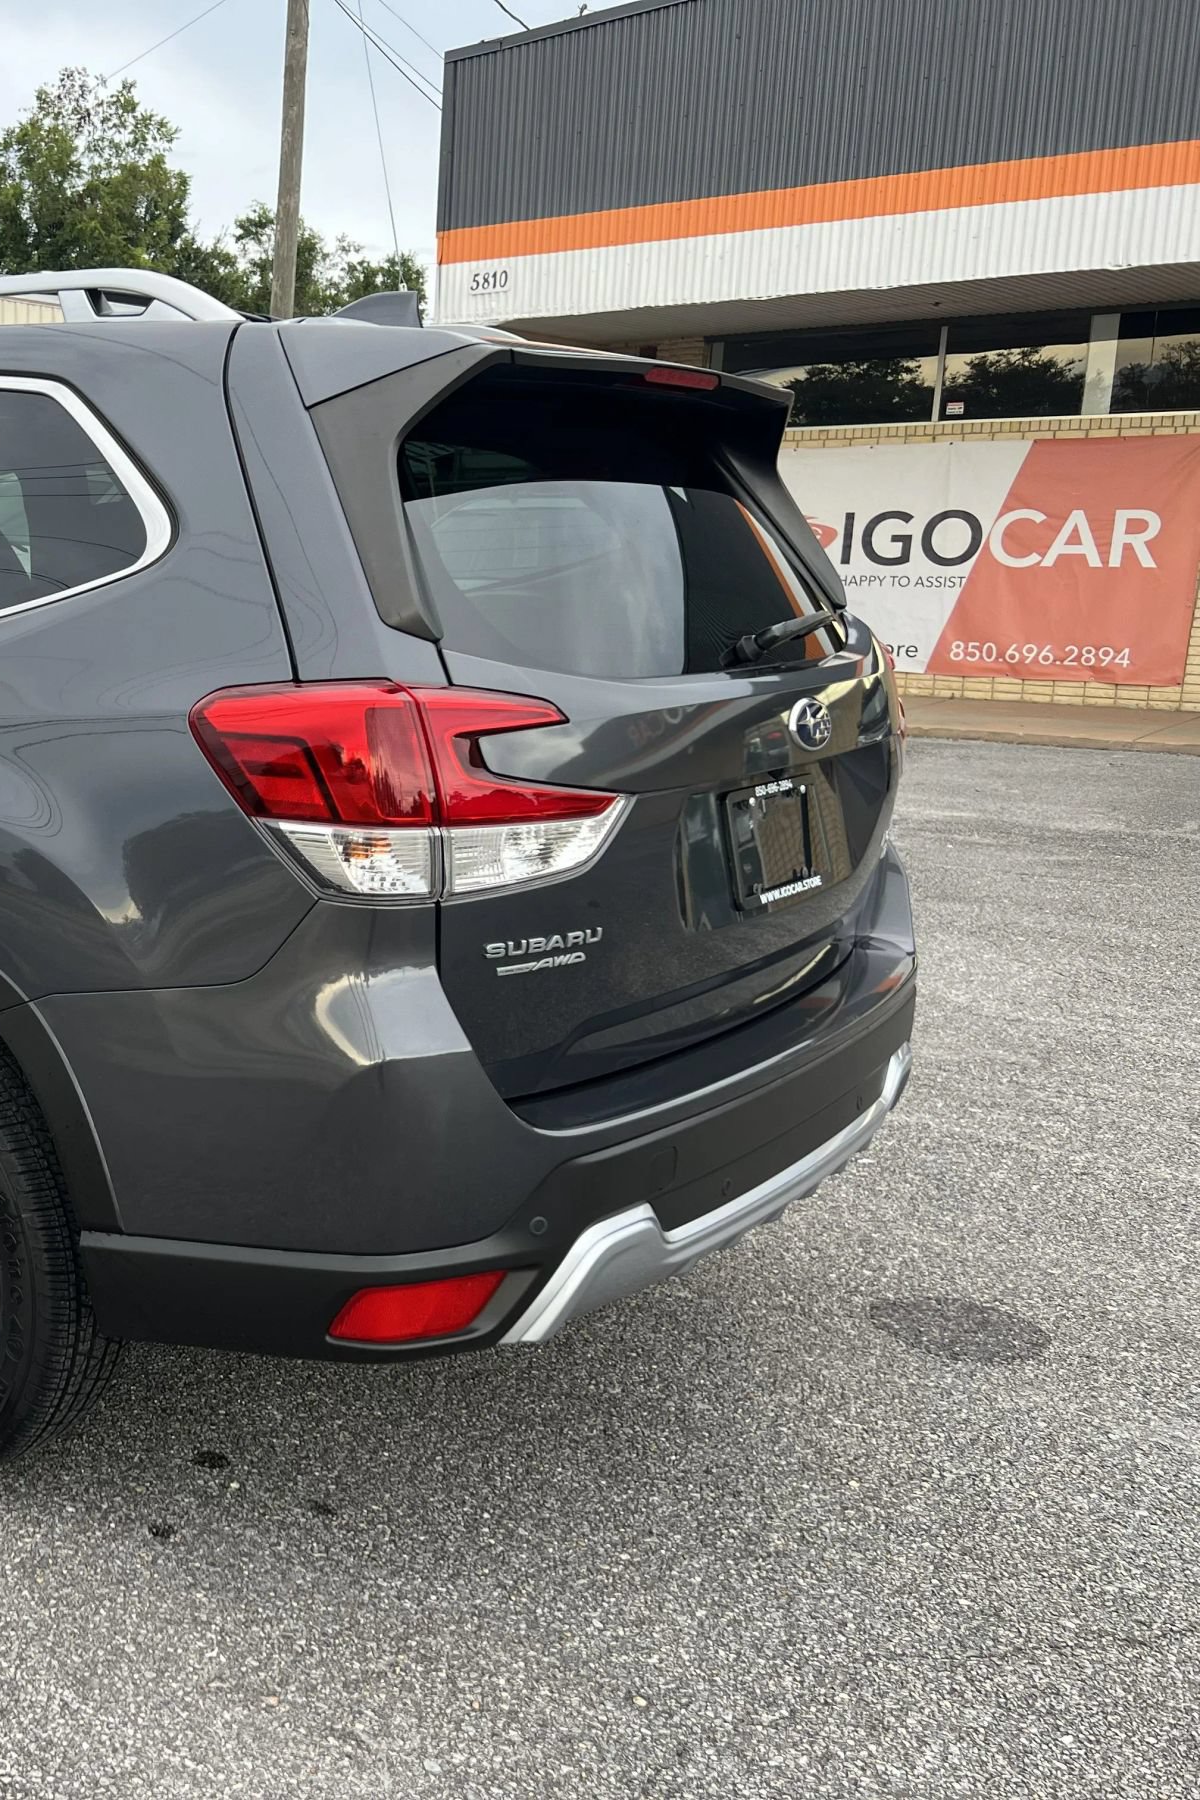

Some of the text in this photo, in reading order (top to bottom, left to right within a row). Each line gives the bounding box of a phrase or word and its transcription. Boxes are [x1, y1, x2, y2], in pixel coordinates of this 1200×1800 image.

[470, 270, 508, 291] 5810
[839, 509, 1161, 568] IGOCAR
[839, 575, 966, 589] HAPPY TO ASSIST
[949, 640, 1131, 668] 850.696.2894
[484, 927, 603, 959] SUBARU
[532, 951, 587, 971] AWD
